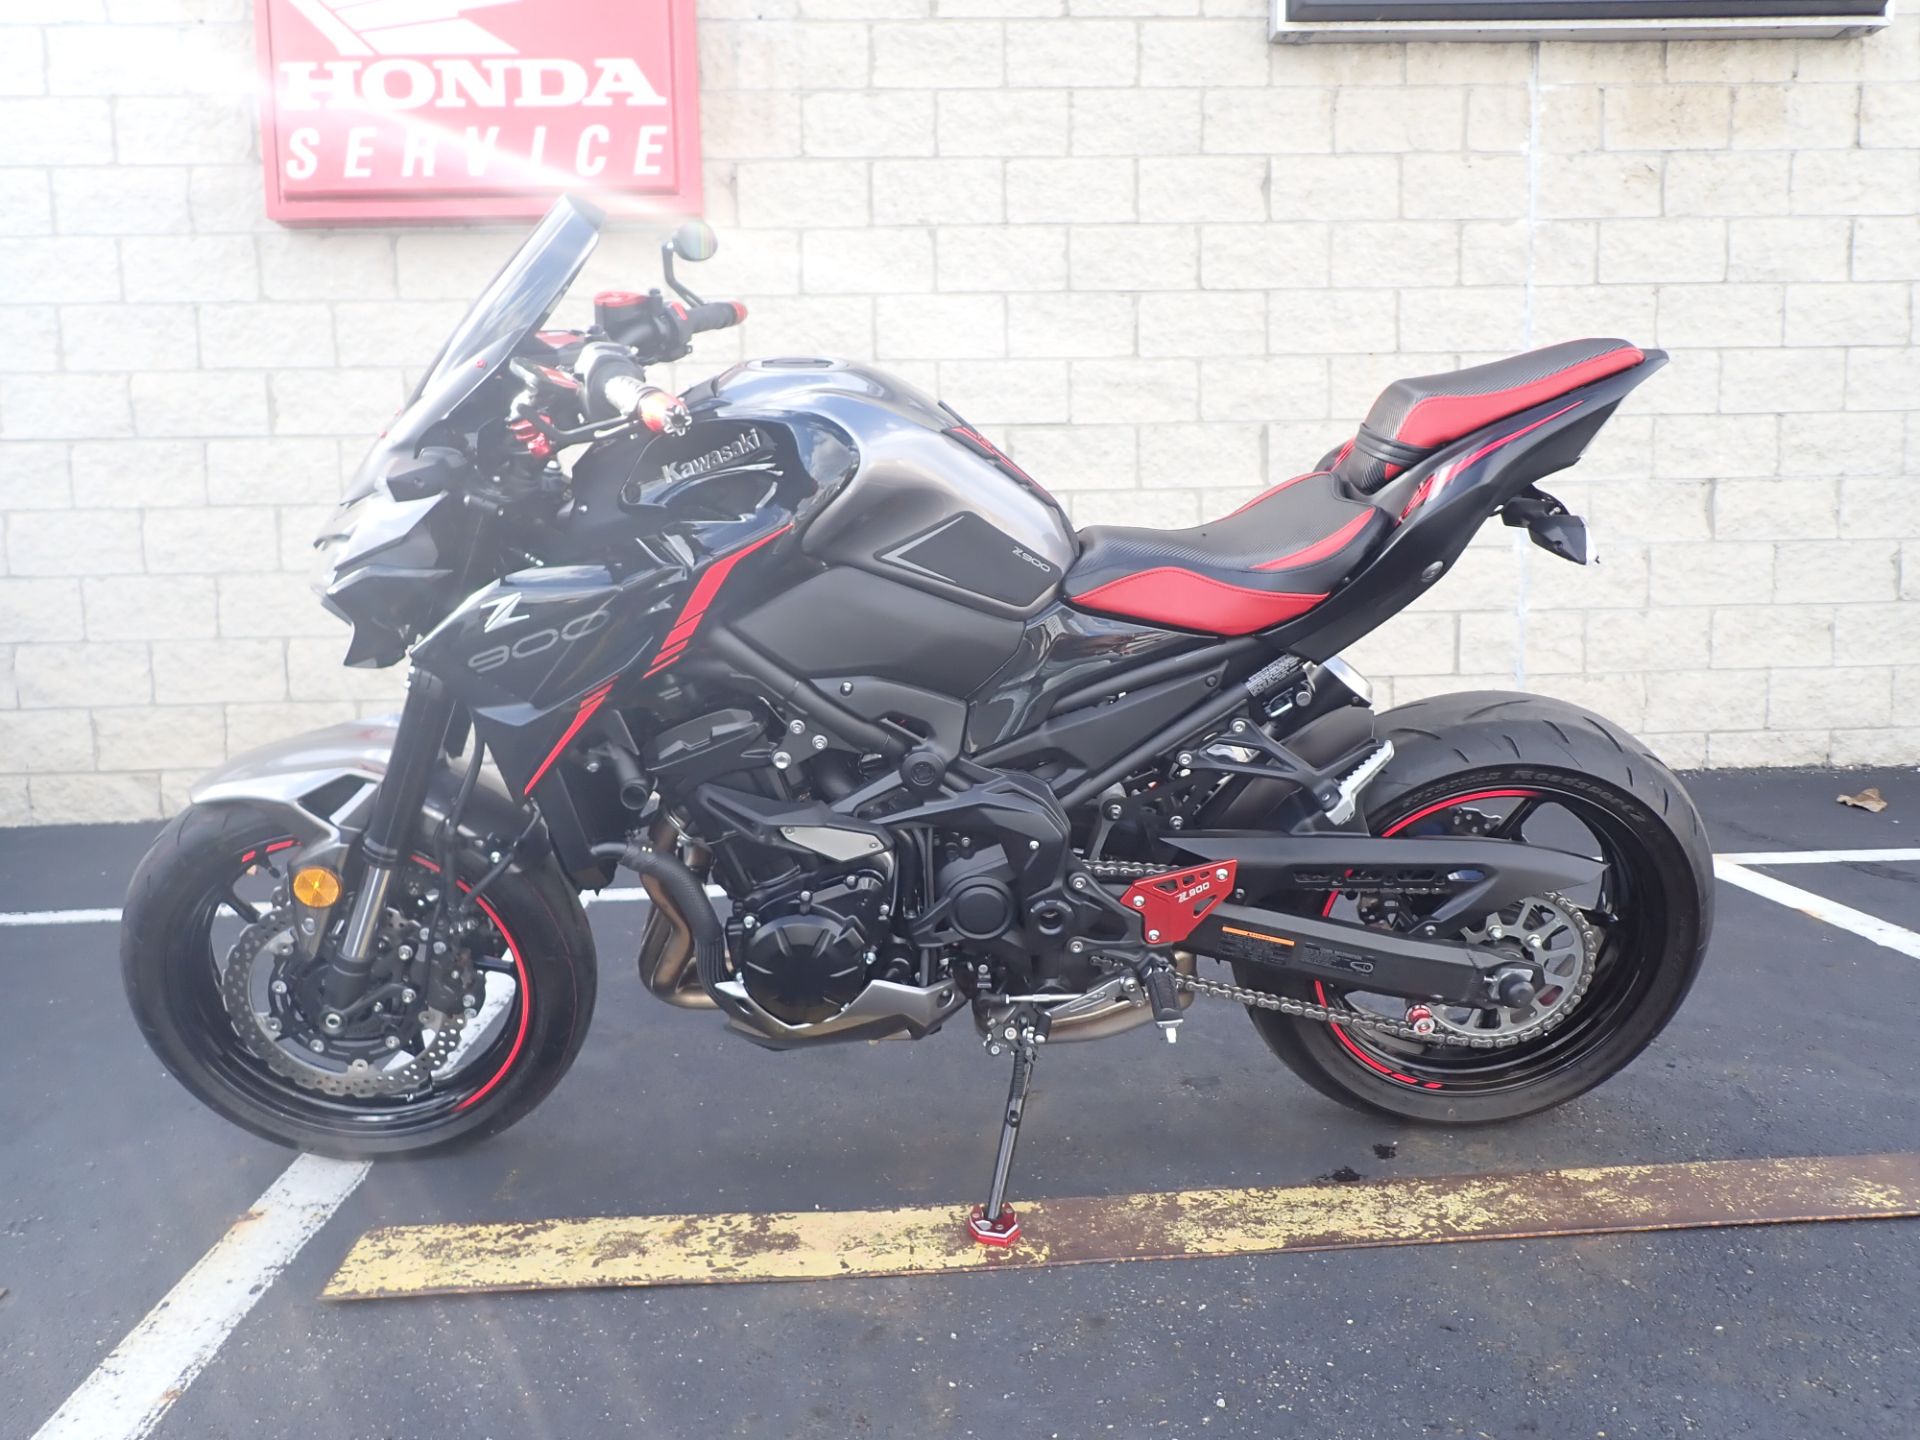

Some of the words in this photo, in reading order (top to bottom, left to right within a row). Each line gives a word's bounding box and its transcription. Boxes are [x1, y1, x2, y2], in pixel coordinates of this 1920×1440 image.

[279, 58, 668, 111] HONDA
[285, 124, 668, 180] SERVICE
[661, 428, 761, 484] Kawasaki
[1012, 545, 1051, 573] Z900
[479, 591, 531, 633] Z
[467, 609, 611, 673] 900
